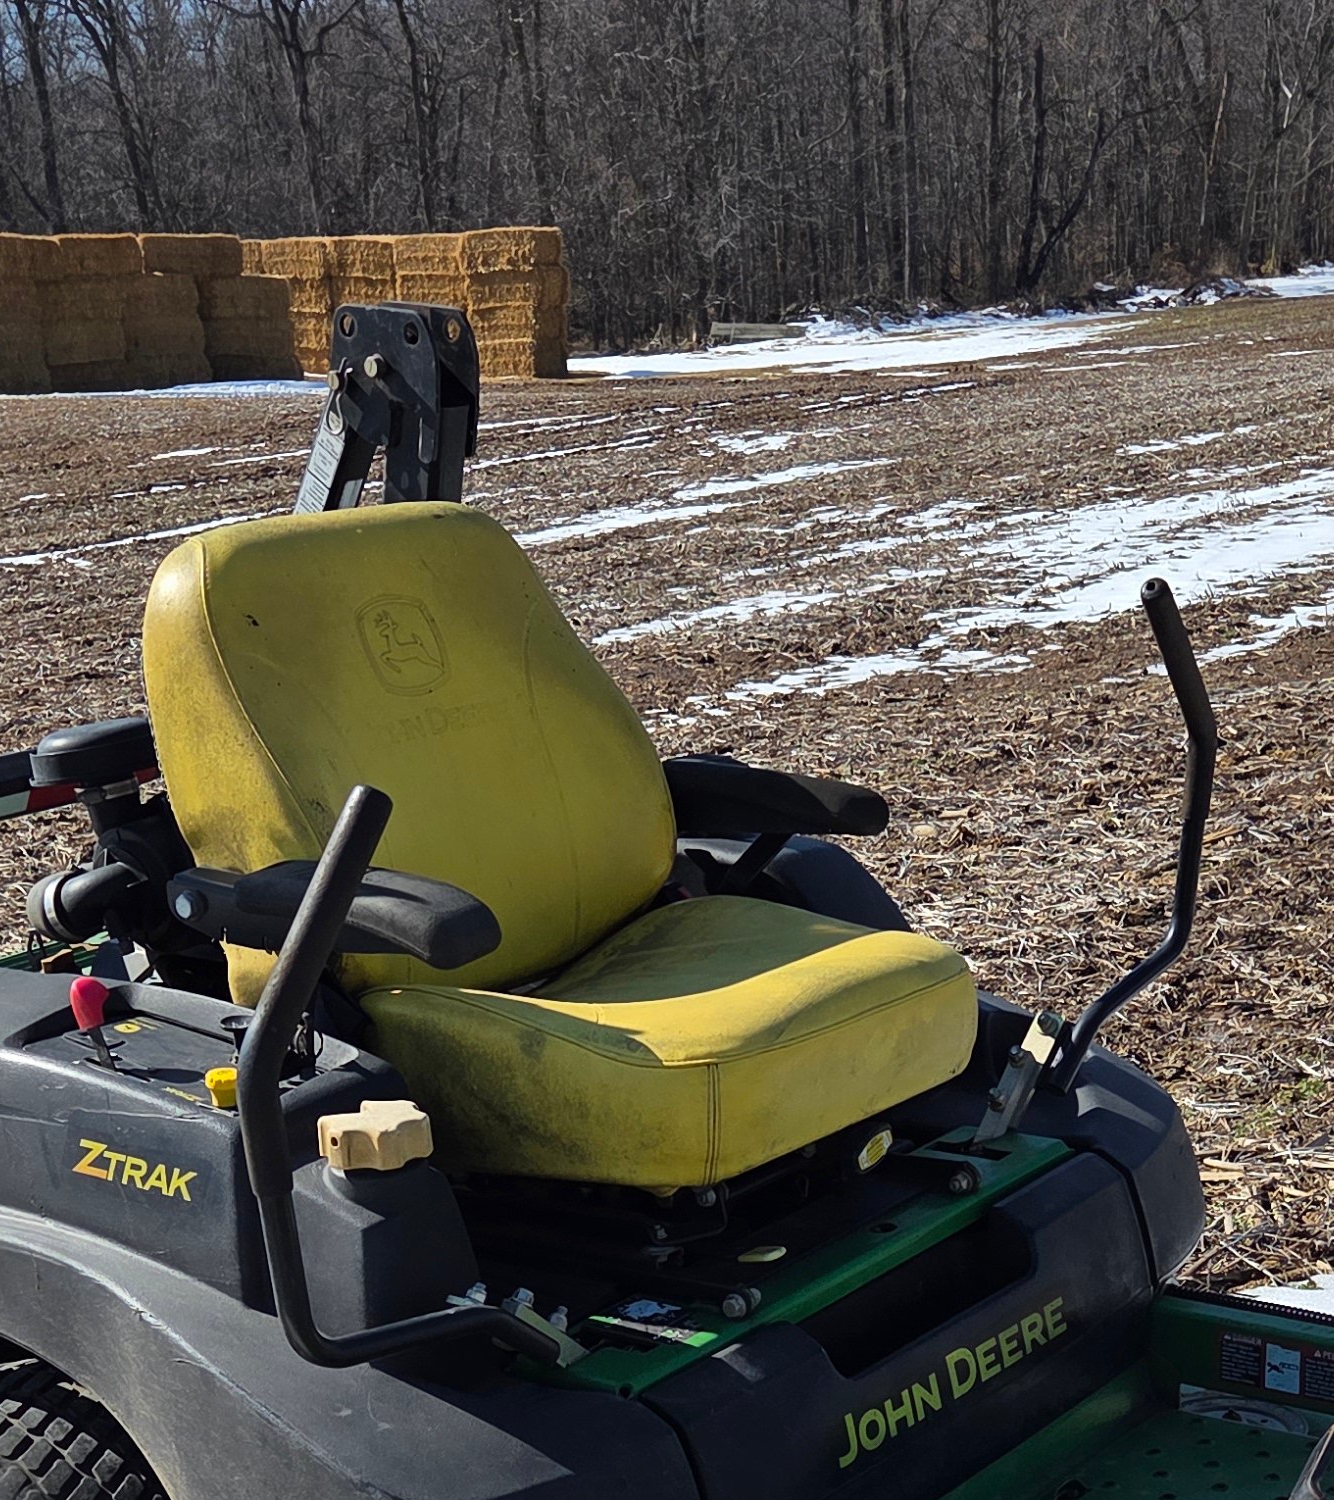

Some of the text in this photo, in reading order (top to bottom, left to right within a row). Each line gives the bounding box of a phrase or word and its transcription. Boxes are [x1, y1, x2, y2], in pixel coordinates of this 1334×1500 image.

[71, 1138, 198, 1202] ZTRAK
[838, 1296, 1068, 1469] JOHN DEERE
